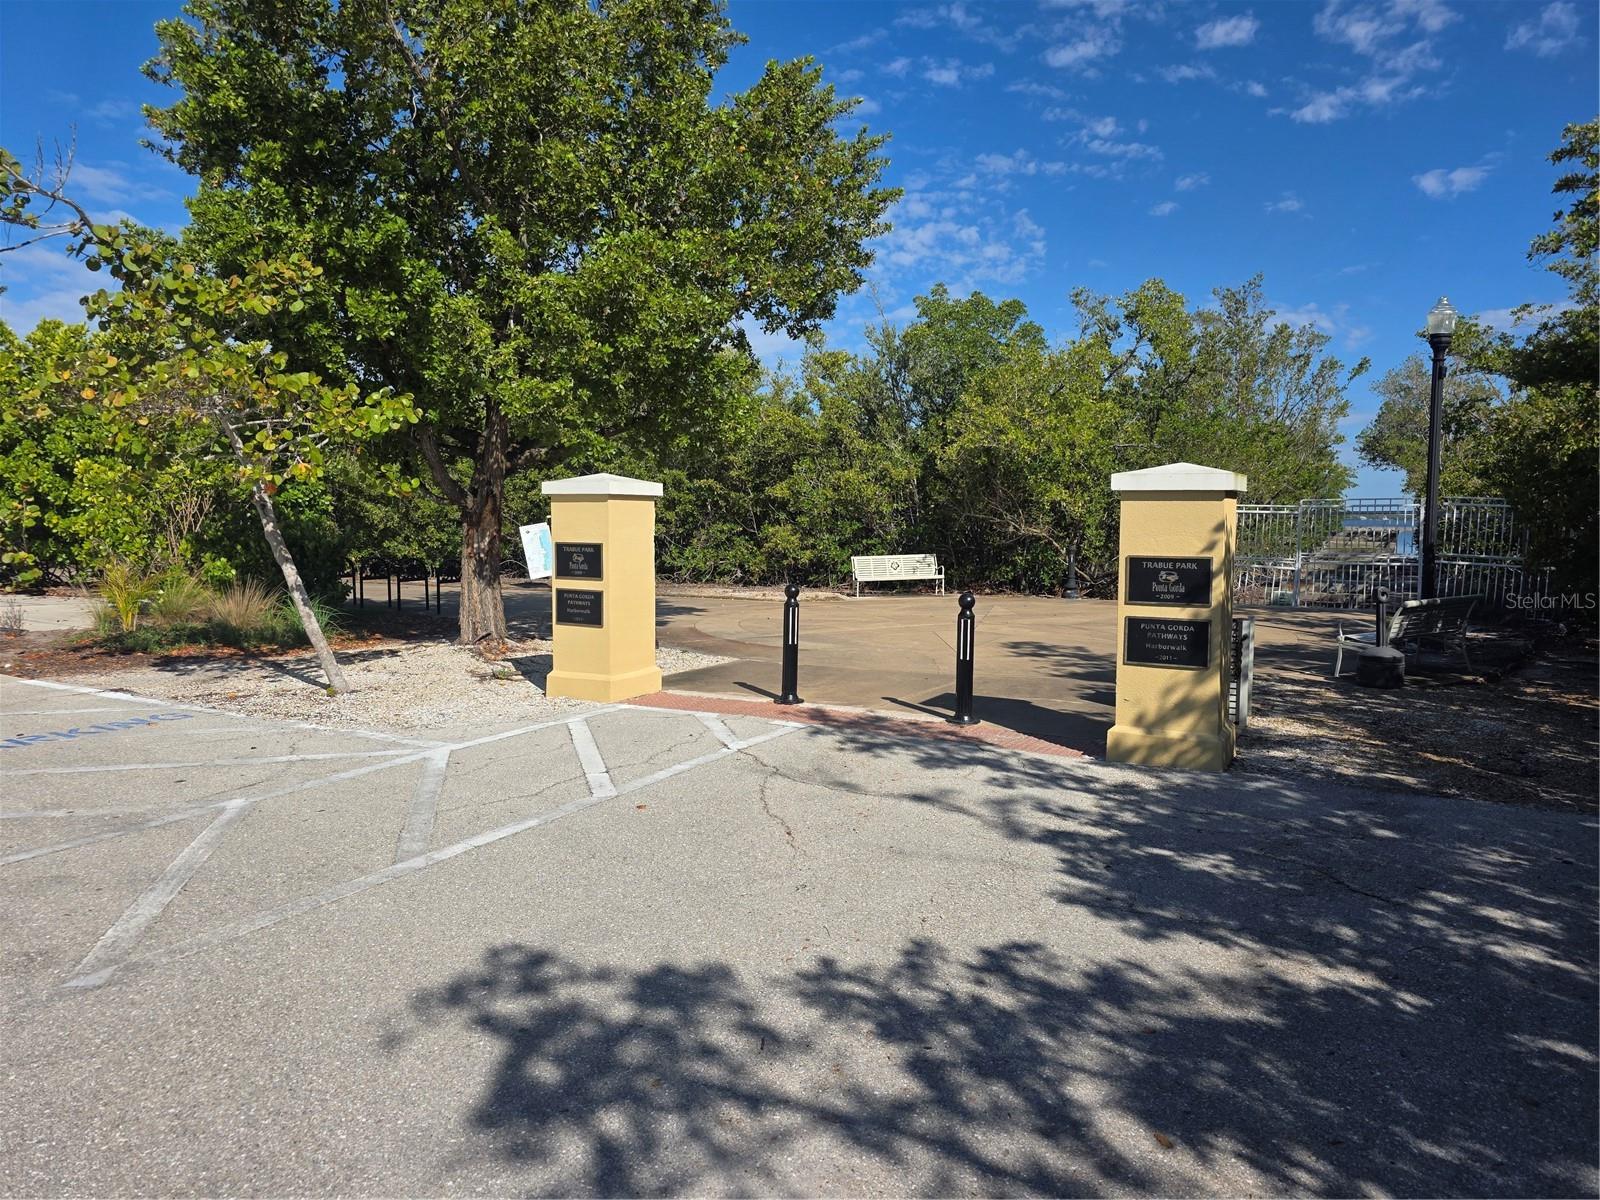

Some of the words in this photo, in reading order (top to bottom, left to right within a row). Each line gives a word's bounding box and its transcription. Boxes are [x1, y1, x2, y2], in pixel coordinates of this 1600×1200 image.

[1142, 561, 1174, 569] TRABUE
[1152, 581, 1168, 592] Punta
[1167, 624, 1195, 632] GORDA
[1147, 632, 1188, 641] PATHWAYS
[1145, 643, 1188, 651] Harborwalk
